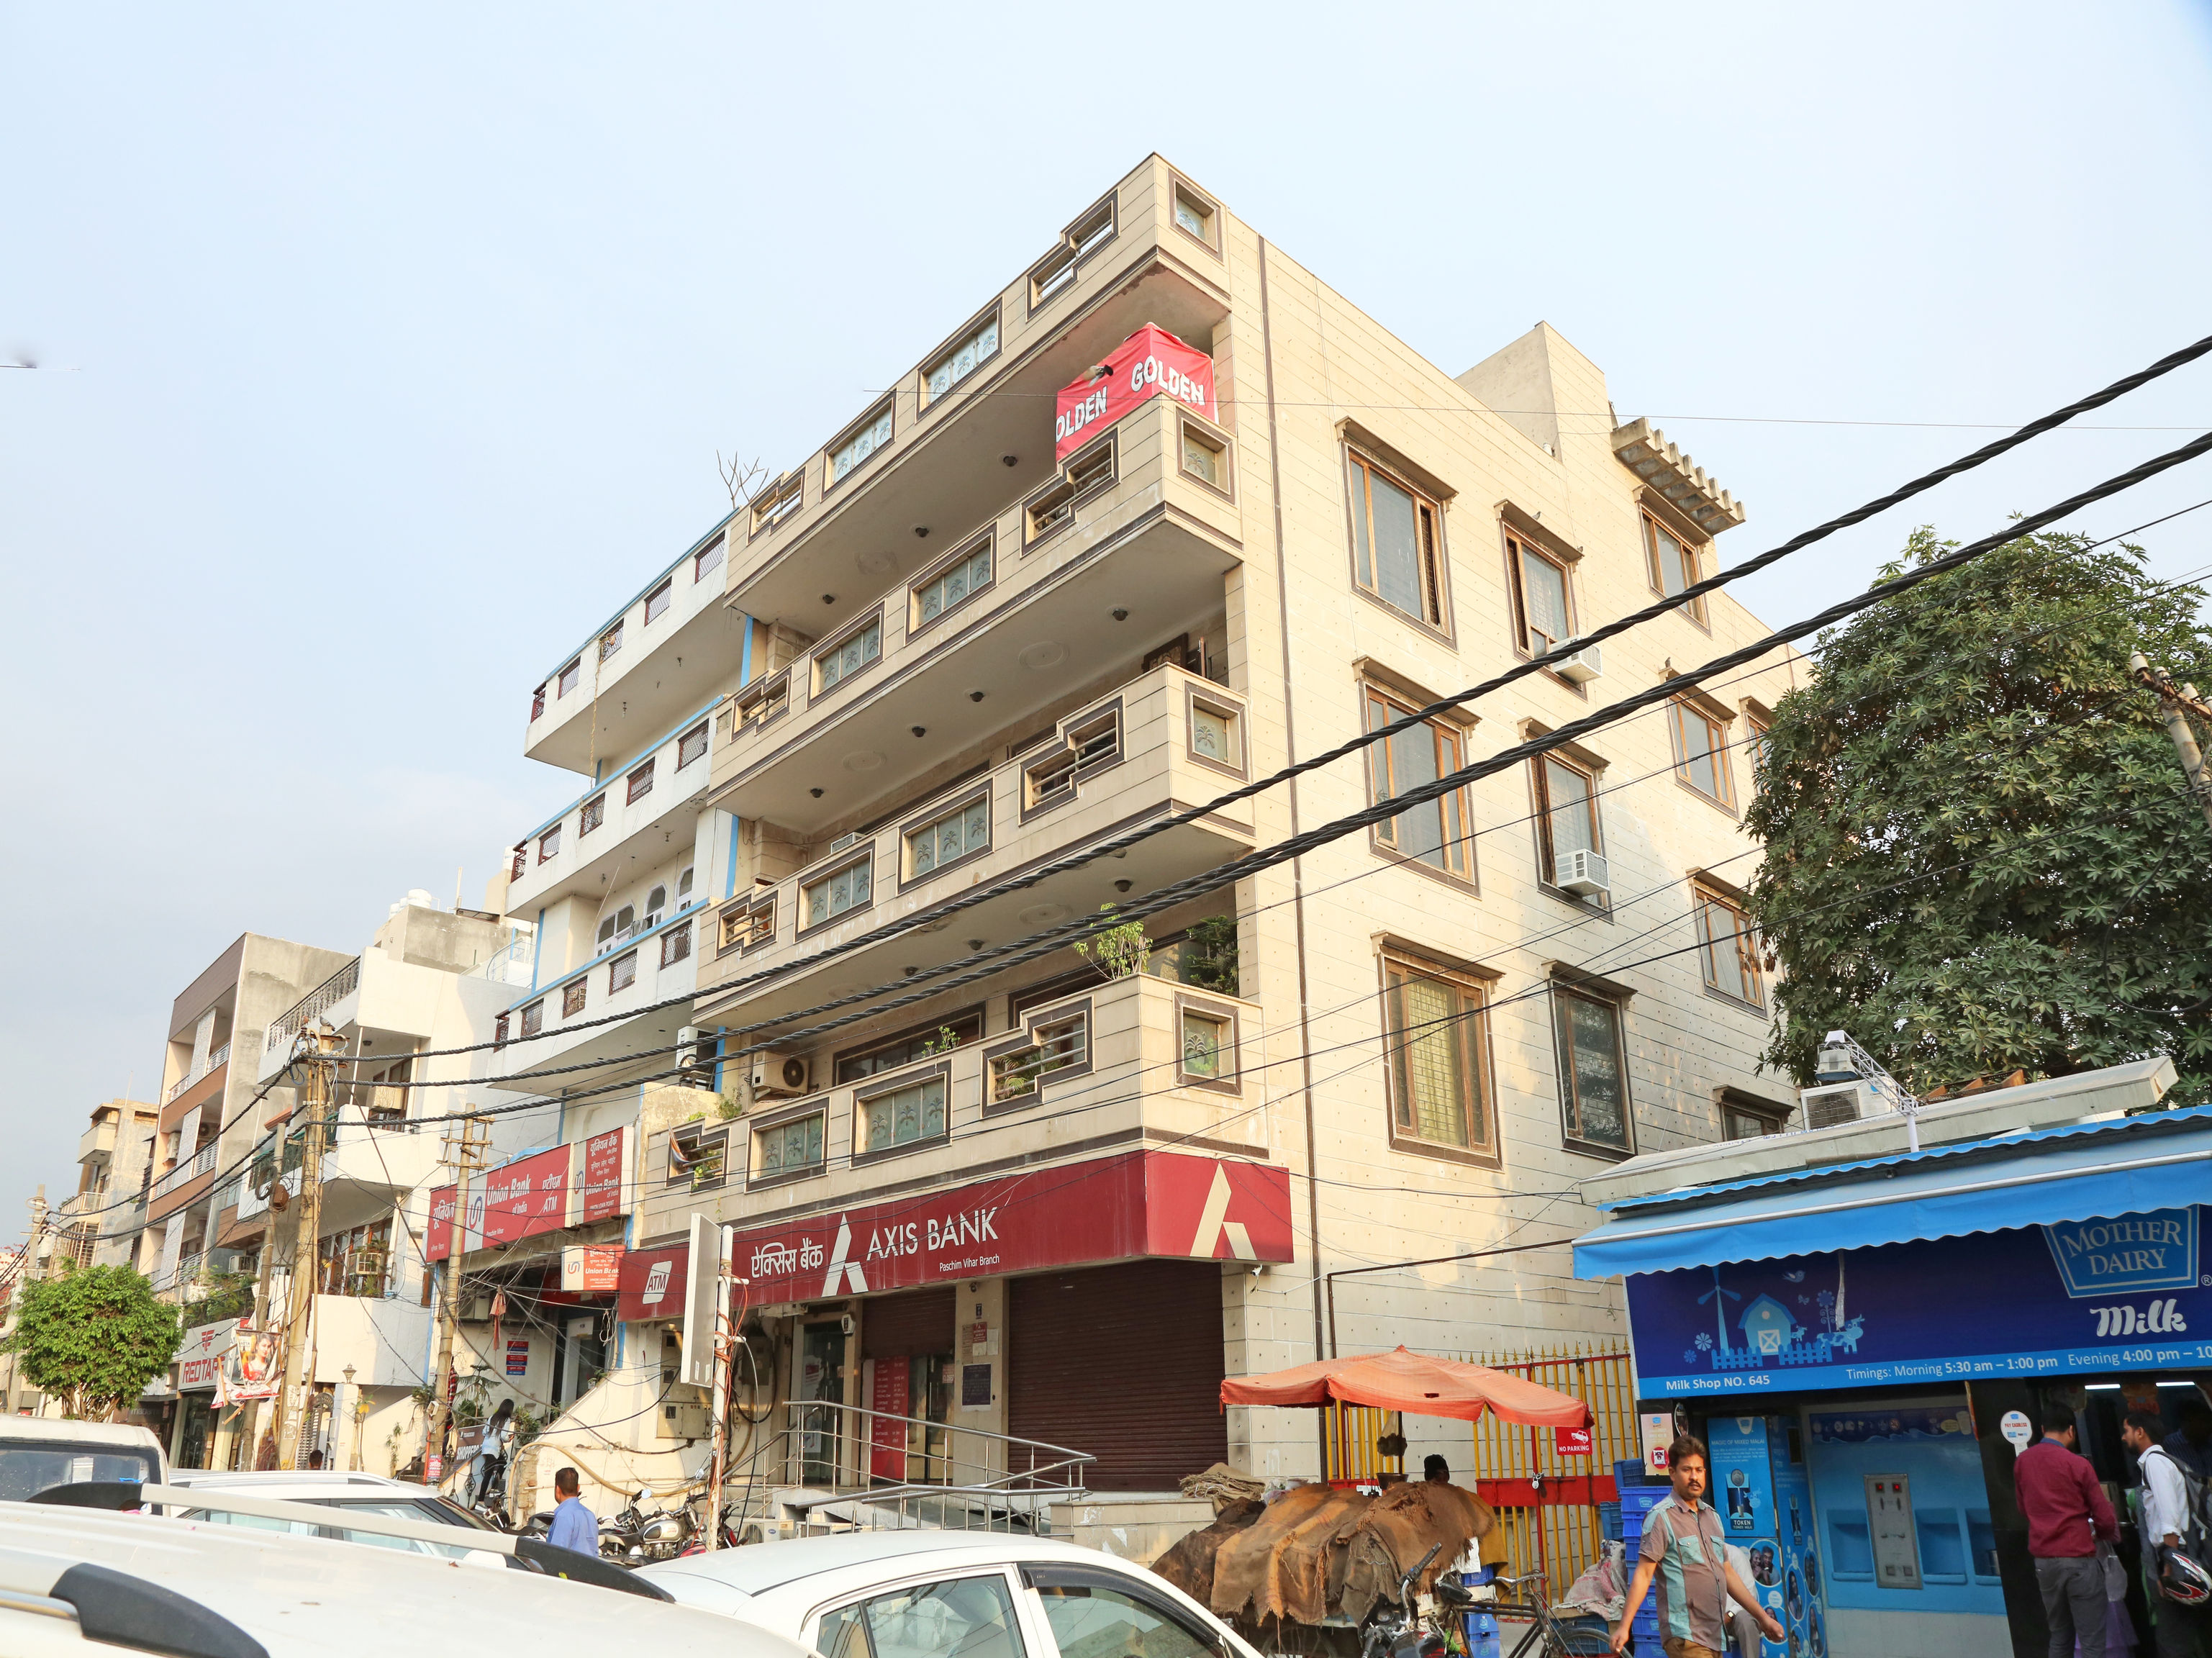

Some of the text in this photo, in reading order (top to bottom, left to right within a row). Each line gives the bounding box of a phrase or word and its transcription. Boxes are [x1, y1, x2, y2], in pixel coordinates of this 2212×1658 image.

[1130, 355, 1205, 405] GOLDEN
[487, 1174, 531, 1206] Union Bank
[586, 1176, 619, 1195] Union Bank
[517, 1201, 527, 1214] India
[543, 1195, 558, 1213] ATM
[866, 1206, 999, 1261] AXIS BANK
[2061, 1219, 2183, 1258] MOTHER
[751, 1237, 823, 1278] ऐक्सिस बैंक
[939, 1253, 1000, 1272] Paschim Vihar Branch
[2088, 1249, 2167, 1275] DAIRY
[647, 1274, 666, 1291] ATM
[2090, 1299, 2187, 1337] Milk
[1846, 1368, 1892, 1380] Timings:
[1895, 1364, 1943, 1377] Morning
[1945, 1362, 1971, 1374] 5:30
[1974, 1362, 1993, 1372] am
[2006, 1356, 2034, 1369] 1:00
[2037, 1357, 2058, 1371] pm
[2068, 1352, 2120, 1366] Evening
[2123, 1349, 2153, 1362] 4:00
[2156, 1349, 2180, 1363] pm
[1666, 1375, 1770, 1390] Milk Shop NO. 645
